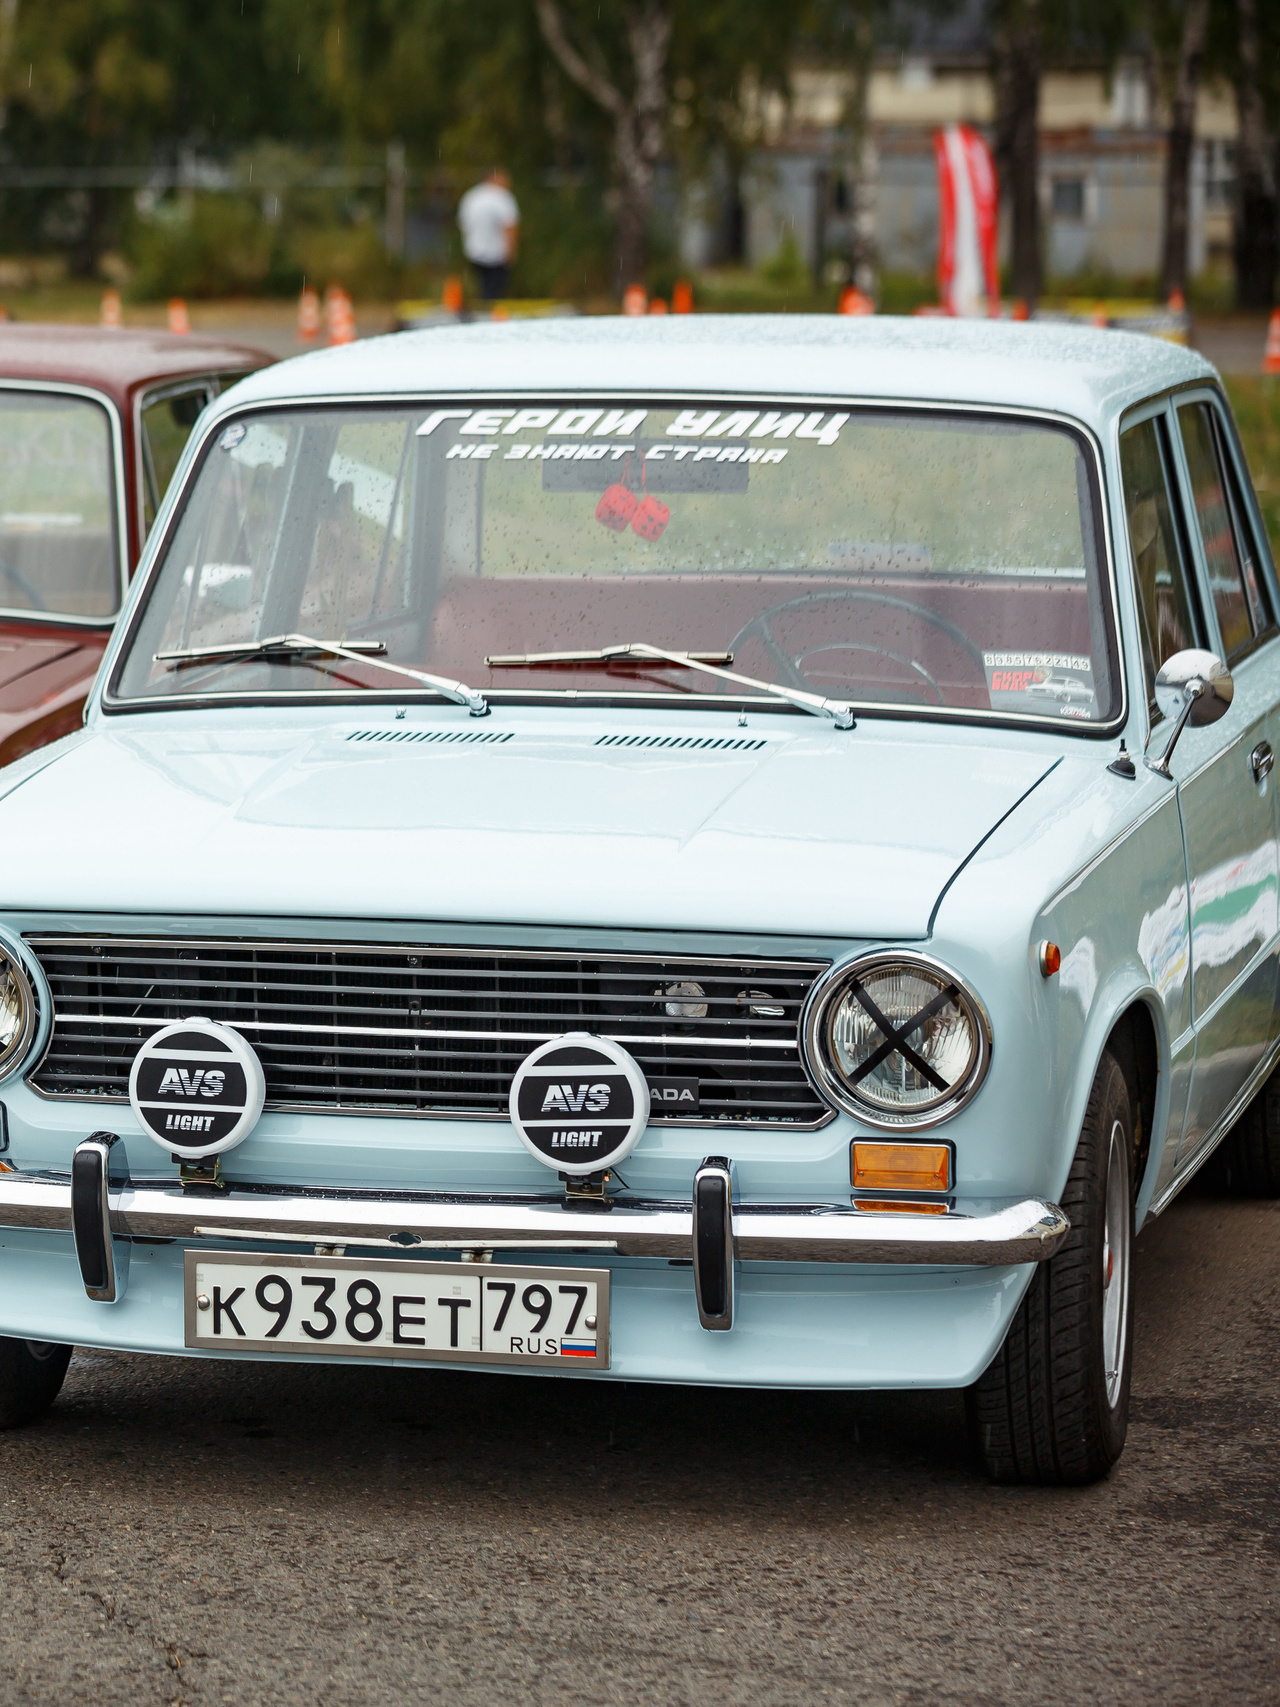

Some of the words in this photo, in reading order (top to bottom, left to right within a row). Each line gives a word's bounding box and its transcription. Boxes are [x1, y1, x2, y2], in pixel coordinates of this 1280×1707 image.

[415, 408, 648, 437] ГЕРОИ
[665, 409, 851, 446] УЛИЦ
[445, 443, 500, 460] НЕ
[504, 443, 635, 461] ЗНАЮТ
[158, 1067, 226, 1098] AVS
[540, 1083, 612, 1112] AVS
[649, 1088, 695, 1102] ADA
[165, 1114, 215, 1132] LIGHT
[551, 1130, 603, 1148] LIGHT
[212, 1273, 472, 1348] К938ЕТ
[486, 1281, 589, 1335] 797
[509, 1336, 559, 1355] RUS
